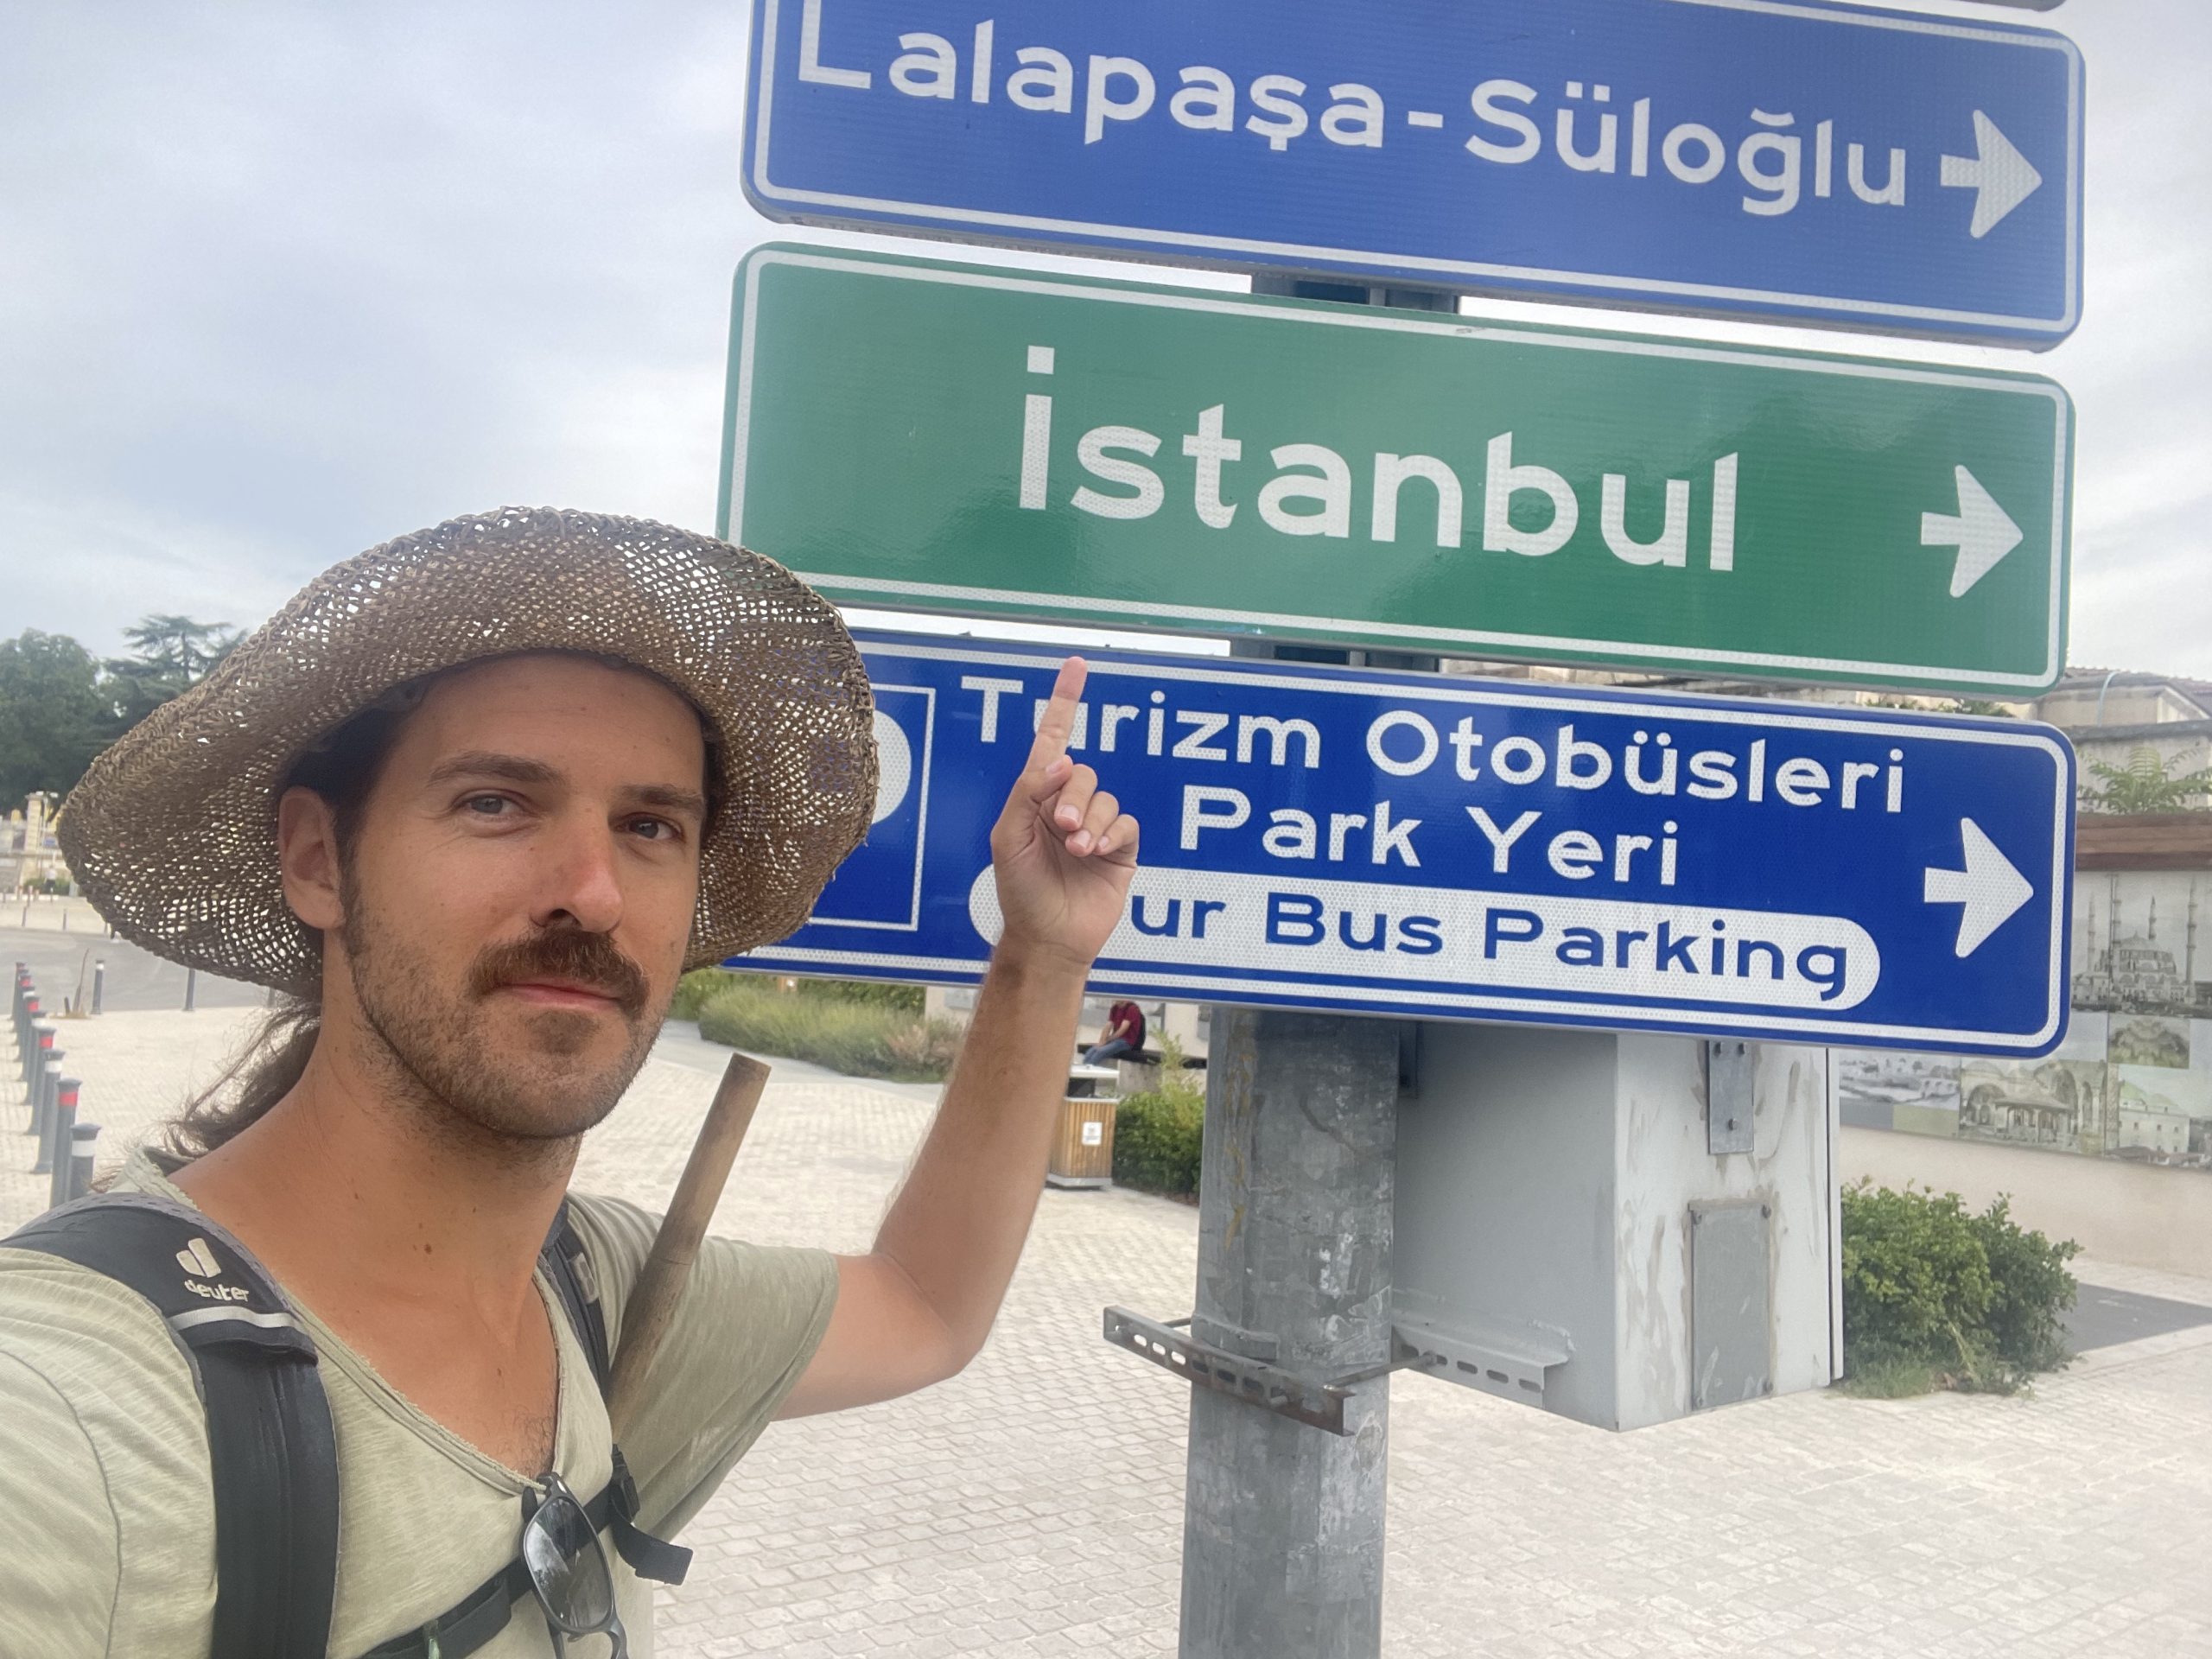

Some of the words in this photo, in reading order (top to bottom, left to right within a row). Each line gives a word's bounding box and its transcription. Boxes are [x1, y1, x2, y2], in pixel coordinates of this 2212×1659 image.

[1019, 344, 1738, 572] İstanbul
[1366, 710, 1904, 813] Otobüsleri
[1180, 785, 1421, 868] Park
[1465, 806, 1679, 886] Yeri
[1265, 892, 1443, 955] Bus
[1484, 908, 1847, 1001] Parking
[184, 1279, 250, 1302] deuter
